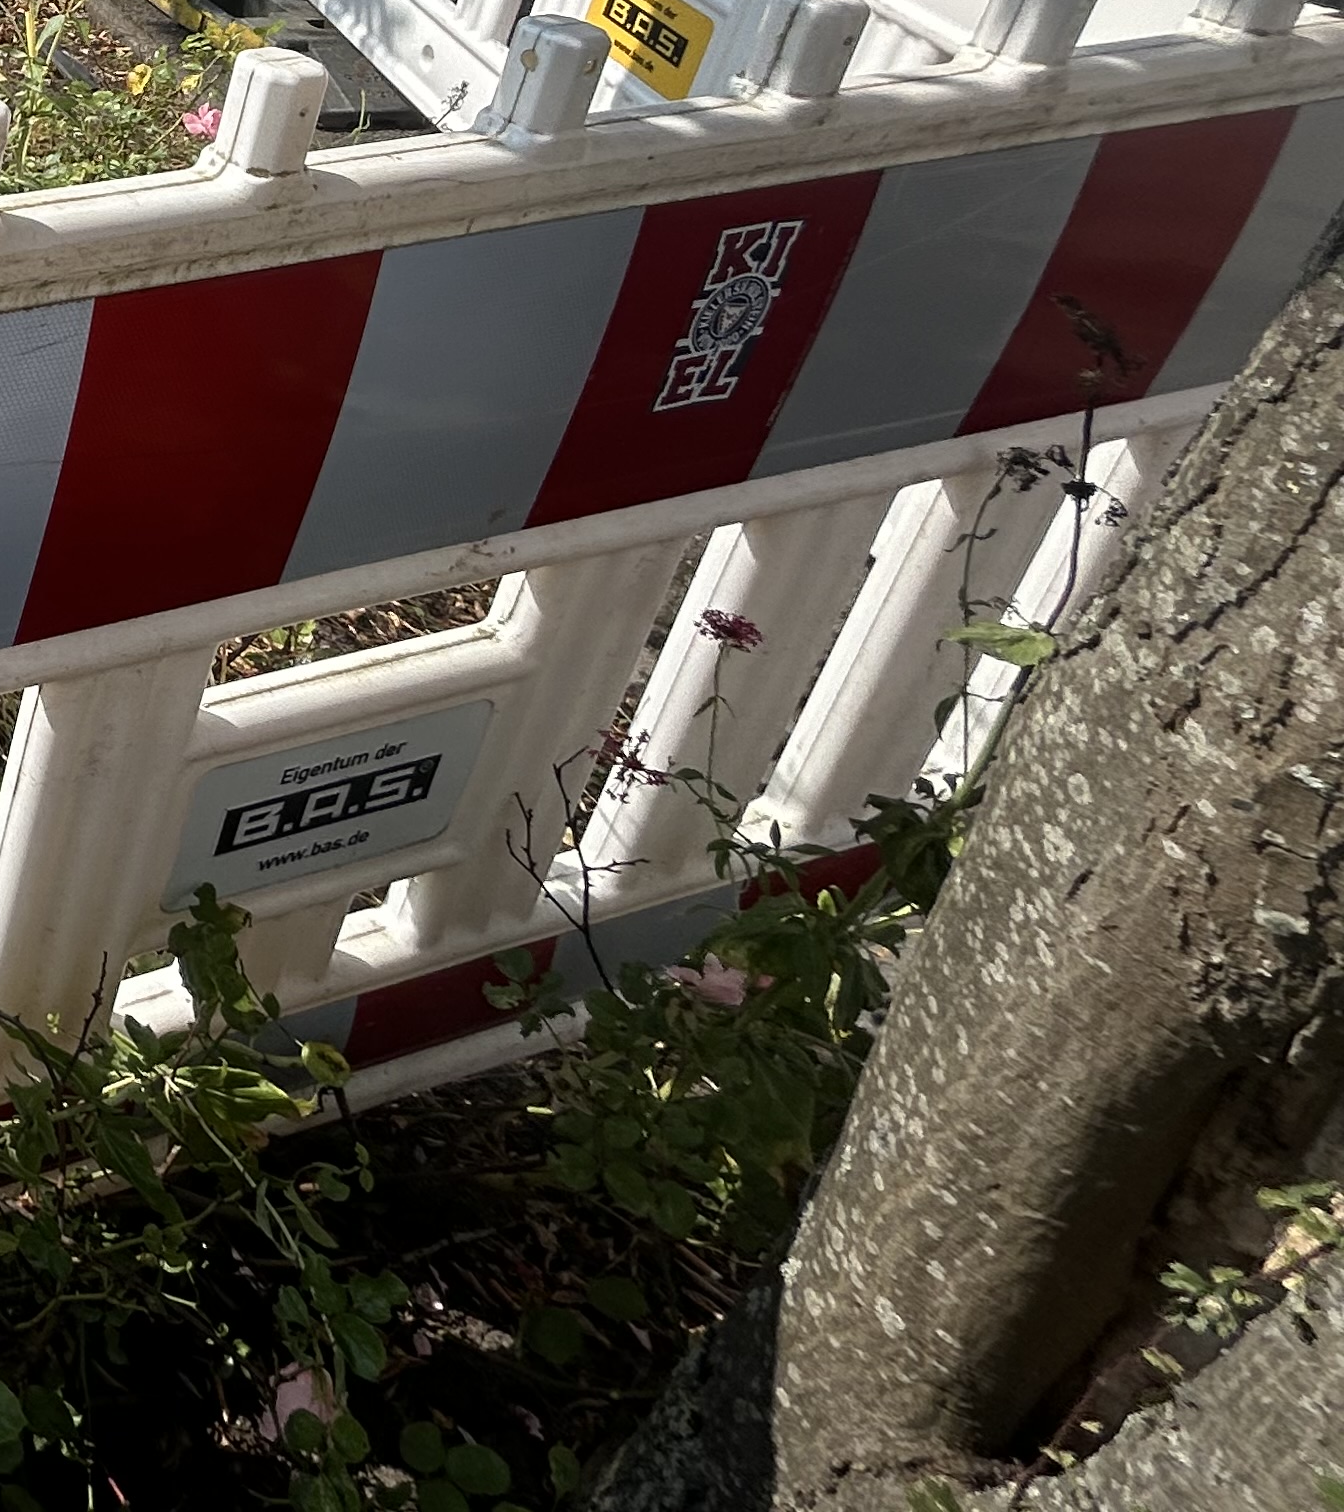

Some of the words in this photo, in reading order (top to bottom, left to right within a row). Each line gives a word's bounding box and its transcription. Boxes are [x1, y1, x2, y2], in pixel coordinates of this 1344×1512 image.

[280, 752, 370, 786] Eigentum
[374, 740, 408, 761] der
[231, 765, 426, 847] B.A.S.
[258, 829, 370, 872] www.bas.de
